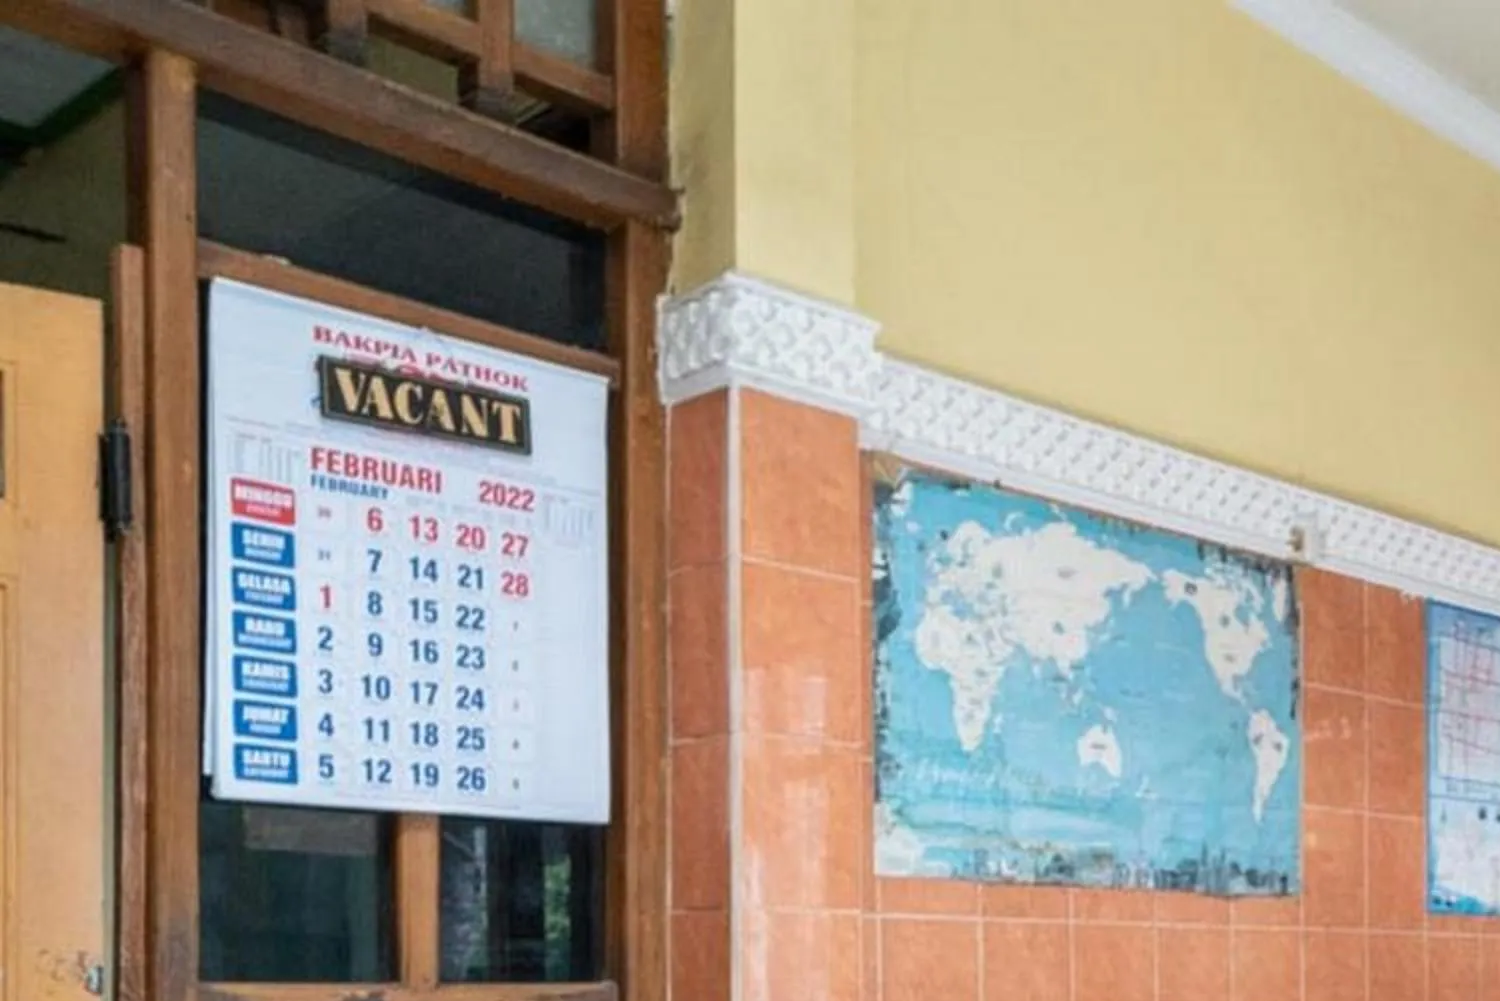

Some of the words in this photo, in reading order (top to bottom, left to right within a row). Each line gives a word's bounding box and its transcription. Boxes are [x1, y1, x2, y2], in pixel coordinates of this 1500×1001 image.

[313, 325, 418, 363] BAKPIA
[426, 351, 529, 392] PATHOK
[334, 367, 524, 445] VACANT
[310, 446, 443, 494] FEBRUARI
[477, 480, 536, 512] 2022
[310, 474, 389, 500] FEBRUARY
[367, 507, 383, 532] 6
[411, 515, 439, 542] 13
[456, 524, 486, 550] 20
[502, 532, 529, 557] 27
[367, 549, 382, 573] 7
[410, 557, 438, 582] 14
[458, 564, 483, 590] 21
[502, 571, 529, 597] 28
[321, 585, 331, 609] 1
[367, 591, 383, 616] 8
[410, 598, 438, 624] 15
[456, 605, 484, 631] 22
[318, 626, 333, 651] 2
[368, 633, 383, 657] 9
[410, 639, 439, 664] 16
[457, 644, 485, 670] 23
[319, 669, 333, 694] 3
[362, 674, 391, 701] 10
[411, 681, 439, 705] 17
[456, 686, 485, 711] 24
[318, 713, 334, 737] 4
[365, 717, 390, 742] 11
[411, 722, 439, 747] 18
[457, 726, 485, 751] 25
[319, 754, 334, 779] 5
[364, 759, 392, 783] 12
[411, 763, 439, 787] 19
[457, 766, 486, 791] 26
